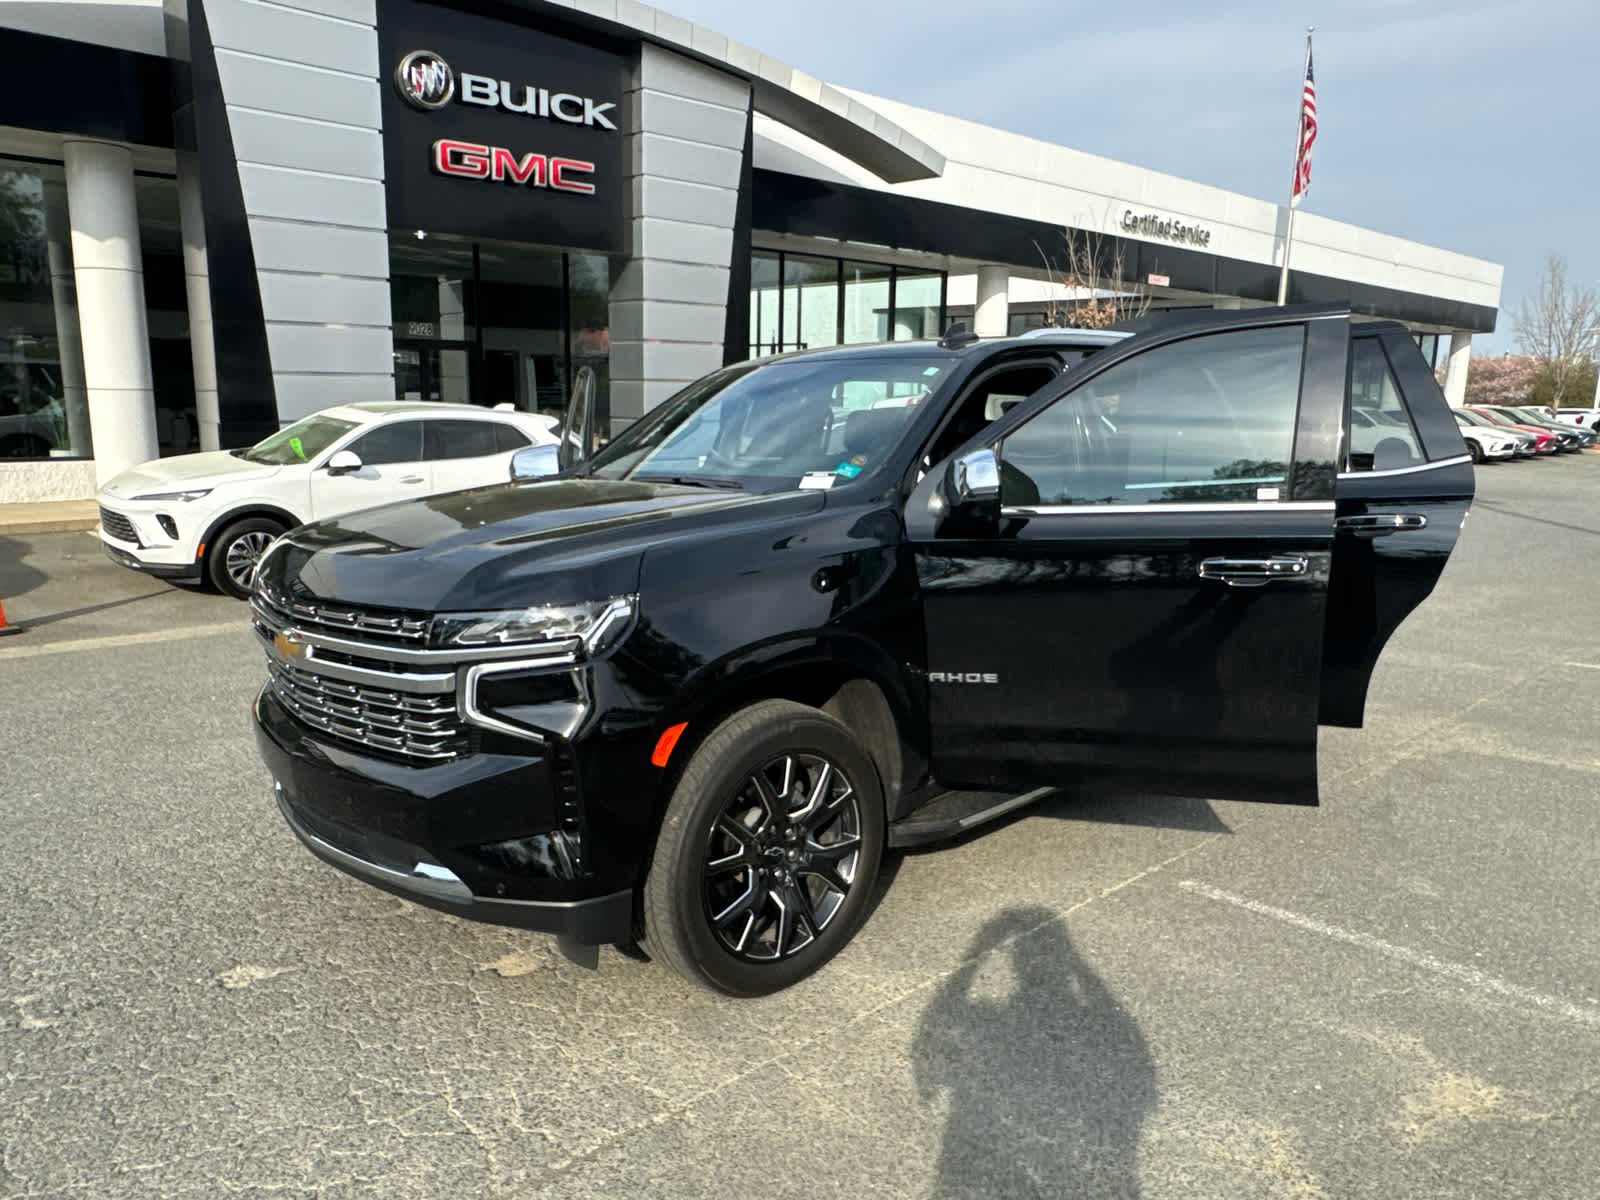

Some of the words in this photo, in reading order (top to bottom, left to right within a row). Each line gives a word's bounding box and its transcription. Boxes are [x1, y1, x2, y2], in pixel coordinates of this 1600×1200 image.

[460, 72, 618, 130] BUICK
[432, 138, 595, 195] GMC
[1121, 209, 1172, 238] Certified
[1173, 220, 1210, 246] Service
[928, 672, 998, 683] AHOE
